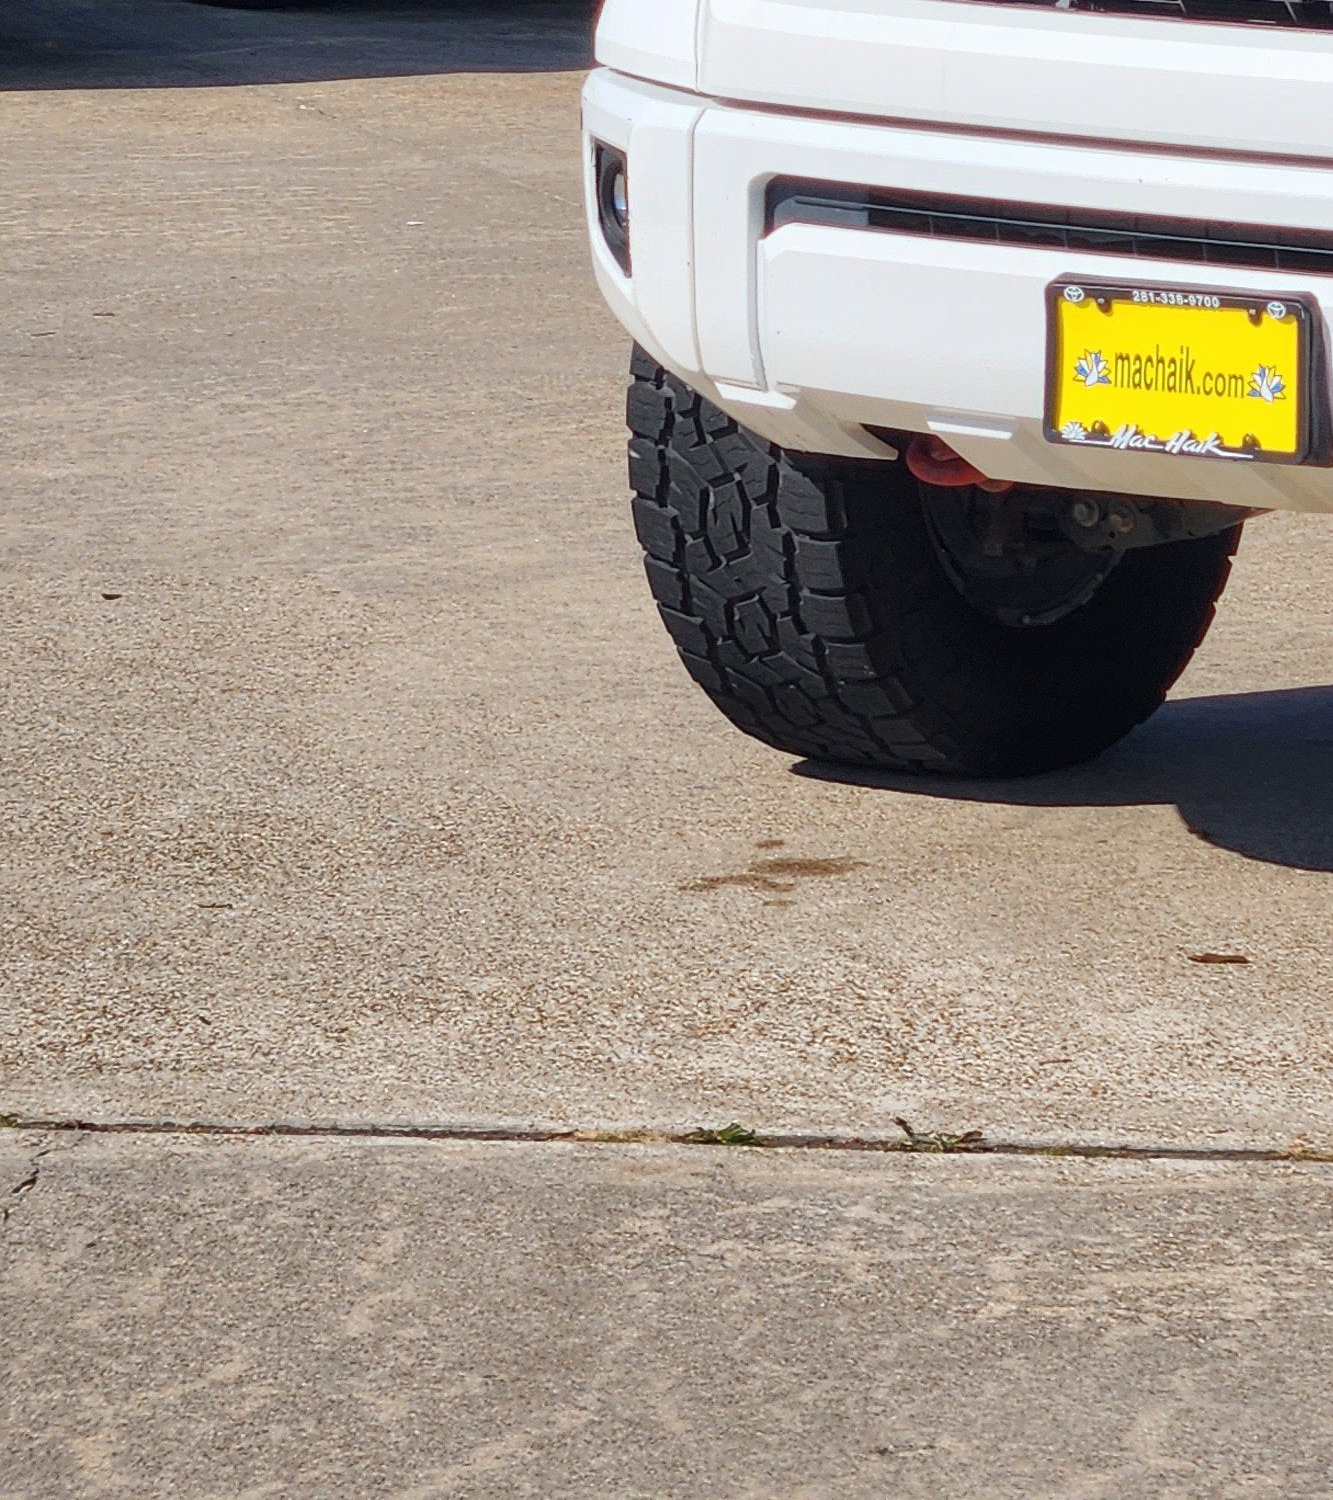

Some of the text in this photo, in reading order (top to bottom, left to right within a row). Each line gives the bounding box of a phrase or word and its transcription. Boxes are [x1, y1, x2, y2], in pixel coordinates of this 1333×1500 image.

[1113, 344, 1246, 399] machaik.com
[1108, 423, 1226, 455] Mac Haik
